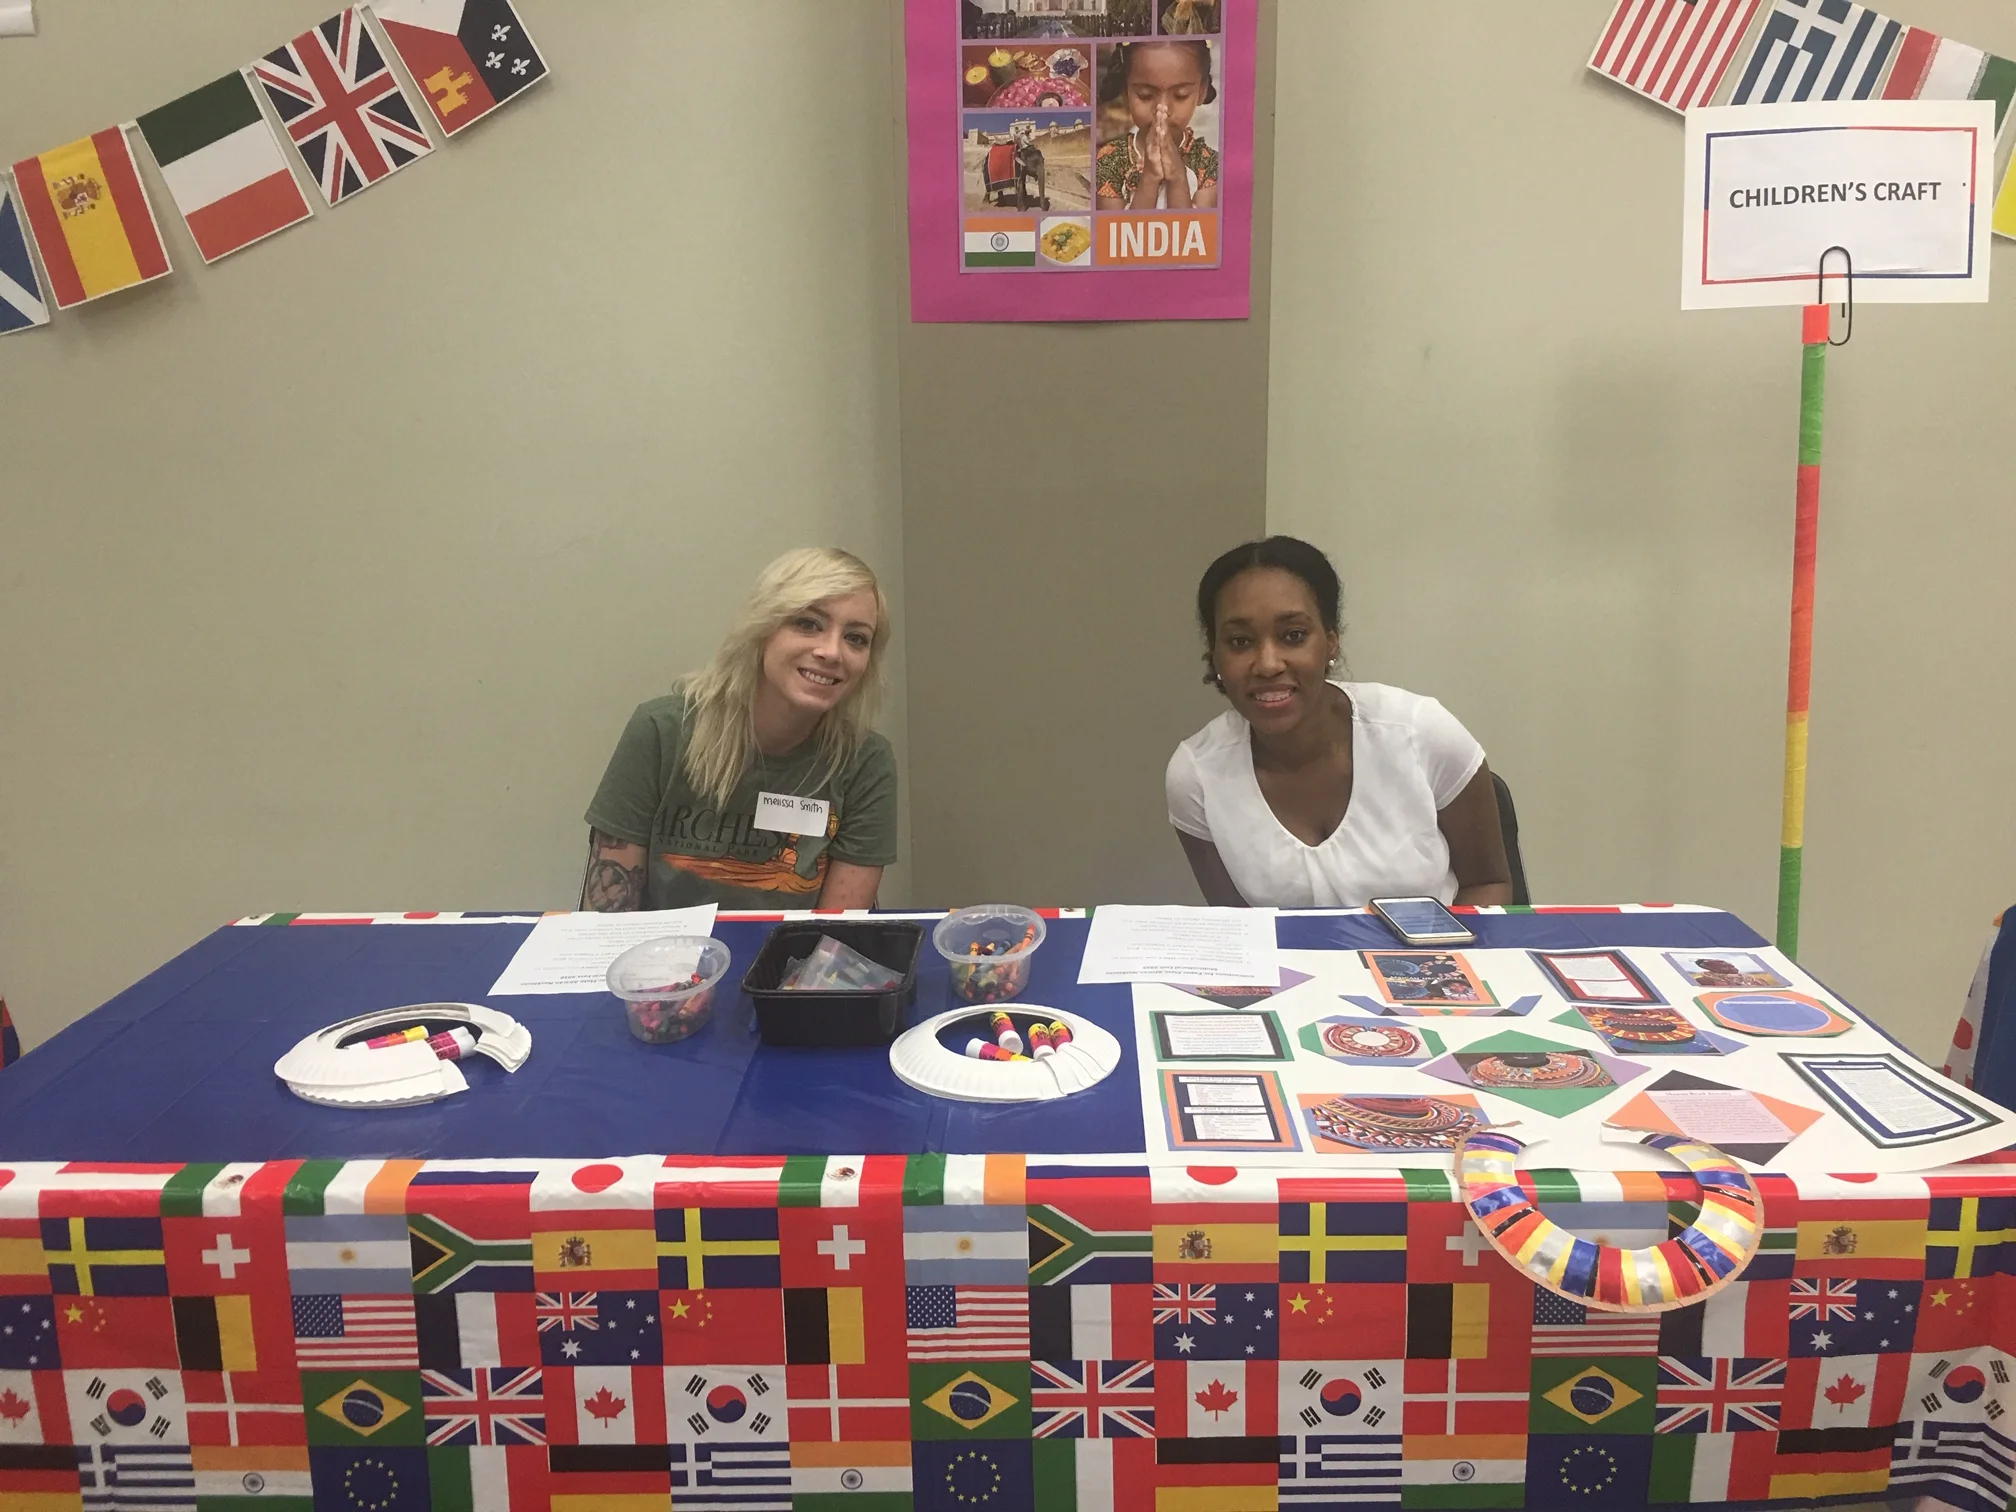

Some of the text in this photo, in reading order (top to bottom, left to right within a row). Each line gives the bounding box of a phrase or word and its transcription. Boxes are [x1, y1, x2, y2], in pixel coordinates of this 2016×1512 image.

[1728, 181, 1942, 209] CHILDREN'S CRAFT
[1109, 220, 1207, 258] INDIA
[800, 800, 823, 814] Smith
[656, 837, 718, 852] NATIONAL
